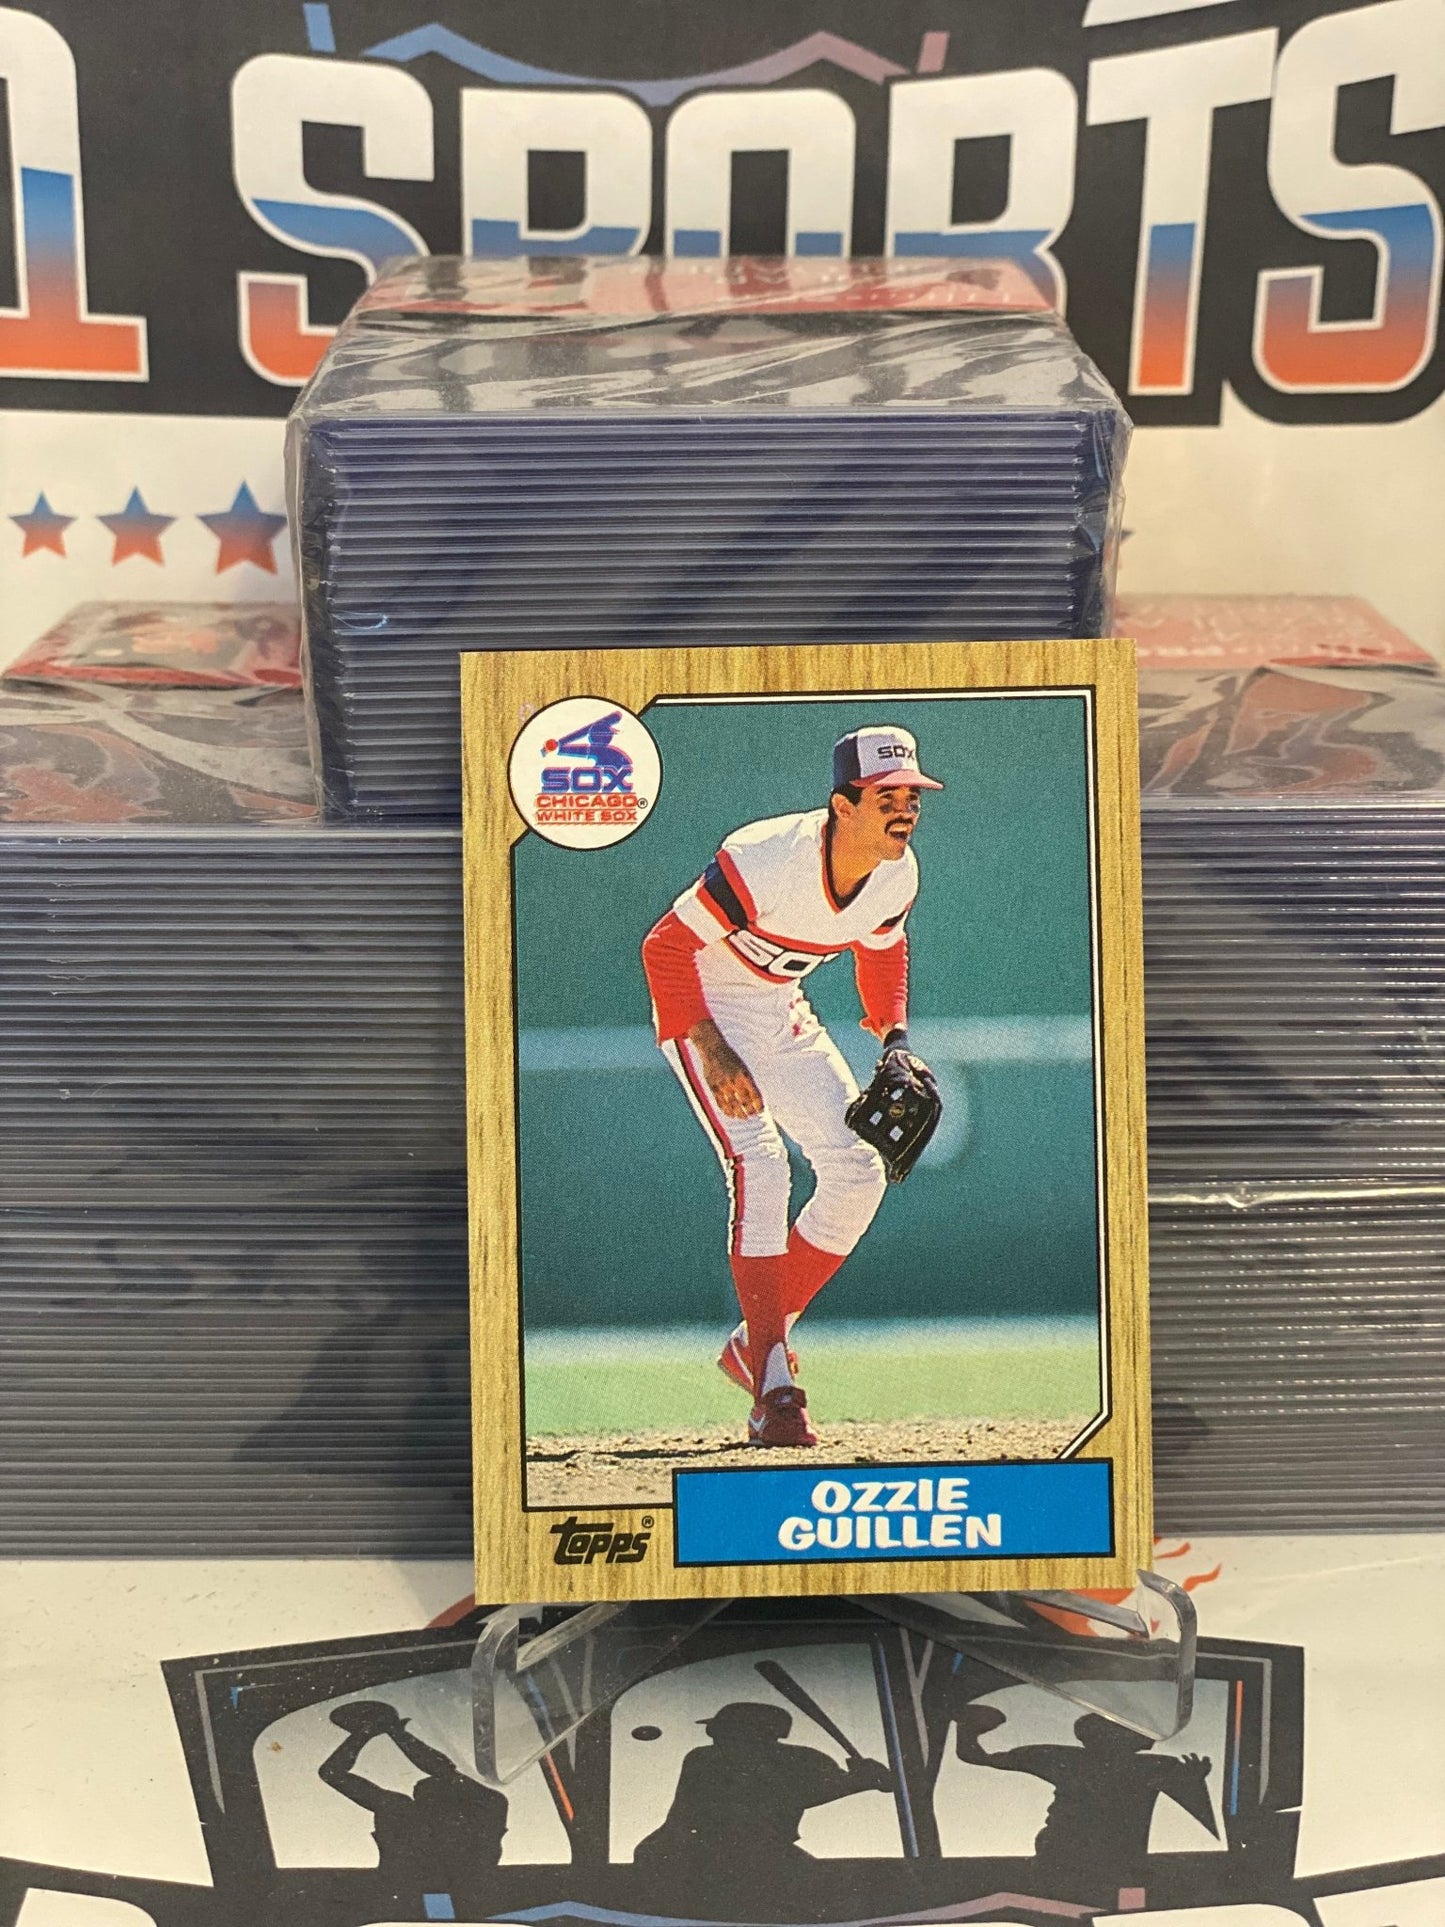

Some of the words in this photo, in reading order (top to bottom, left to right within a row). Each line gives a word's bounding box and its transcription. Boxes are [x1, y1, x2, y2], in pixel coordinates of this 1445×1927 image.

[231, 0, 1445, 397] SPORTS
[877, 745, 914, 761] SOX
[541, 767, 633, 794] SOX
[536, 810, 595, 821] WHITE
[600, 810, 638, 821] SOX
[728, 929, 840, 979] SO
[811, 1477, 970, 1514] OZZIE
[778, 1513, 1002, 1550] GUILLEN
